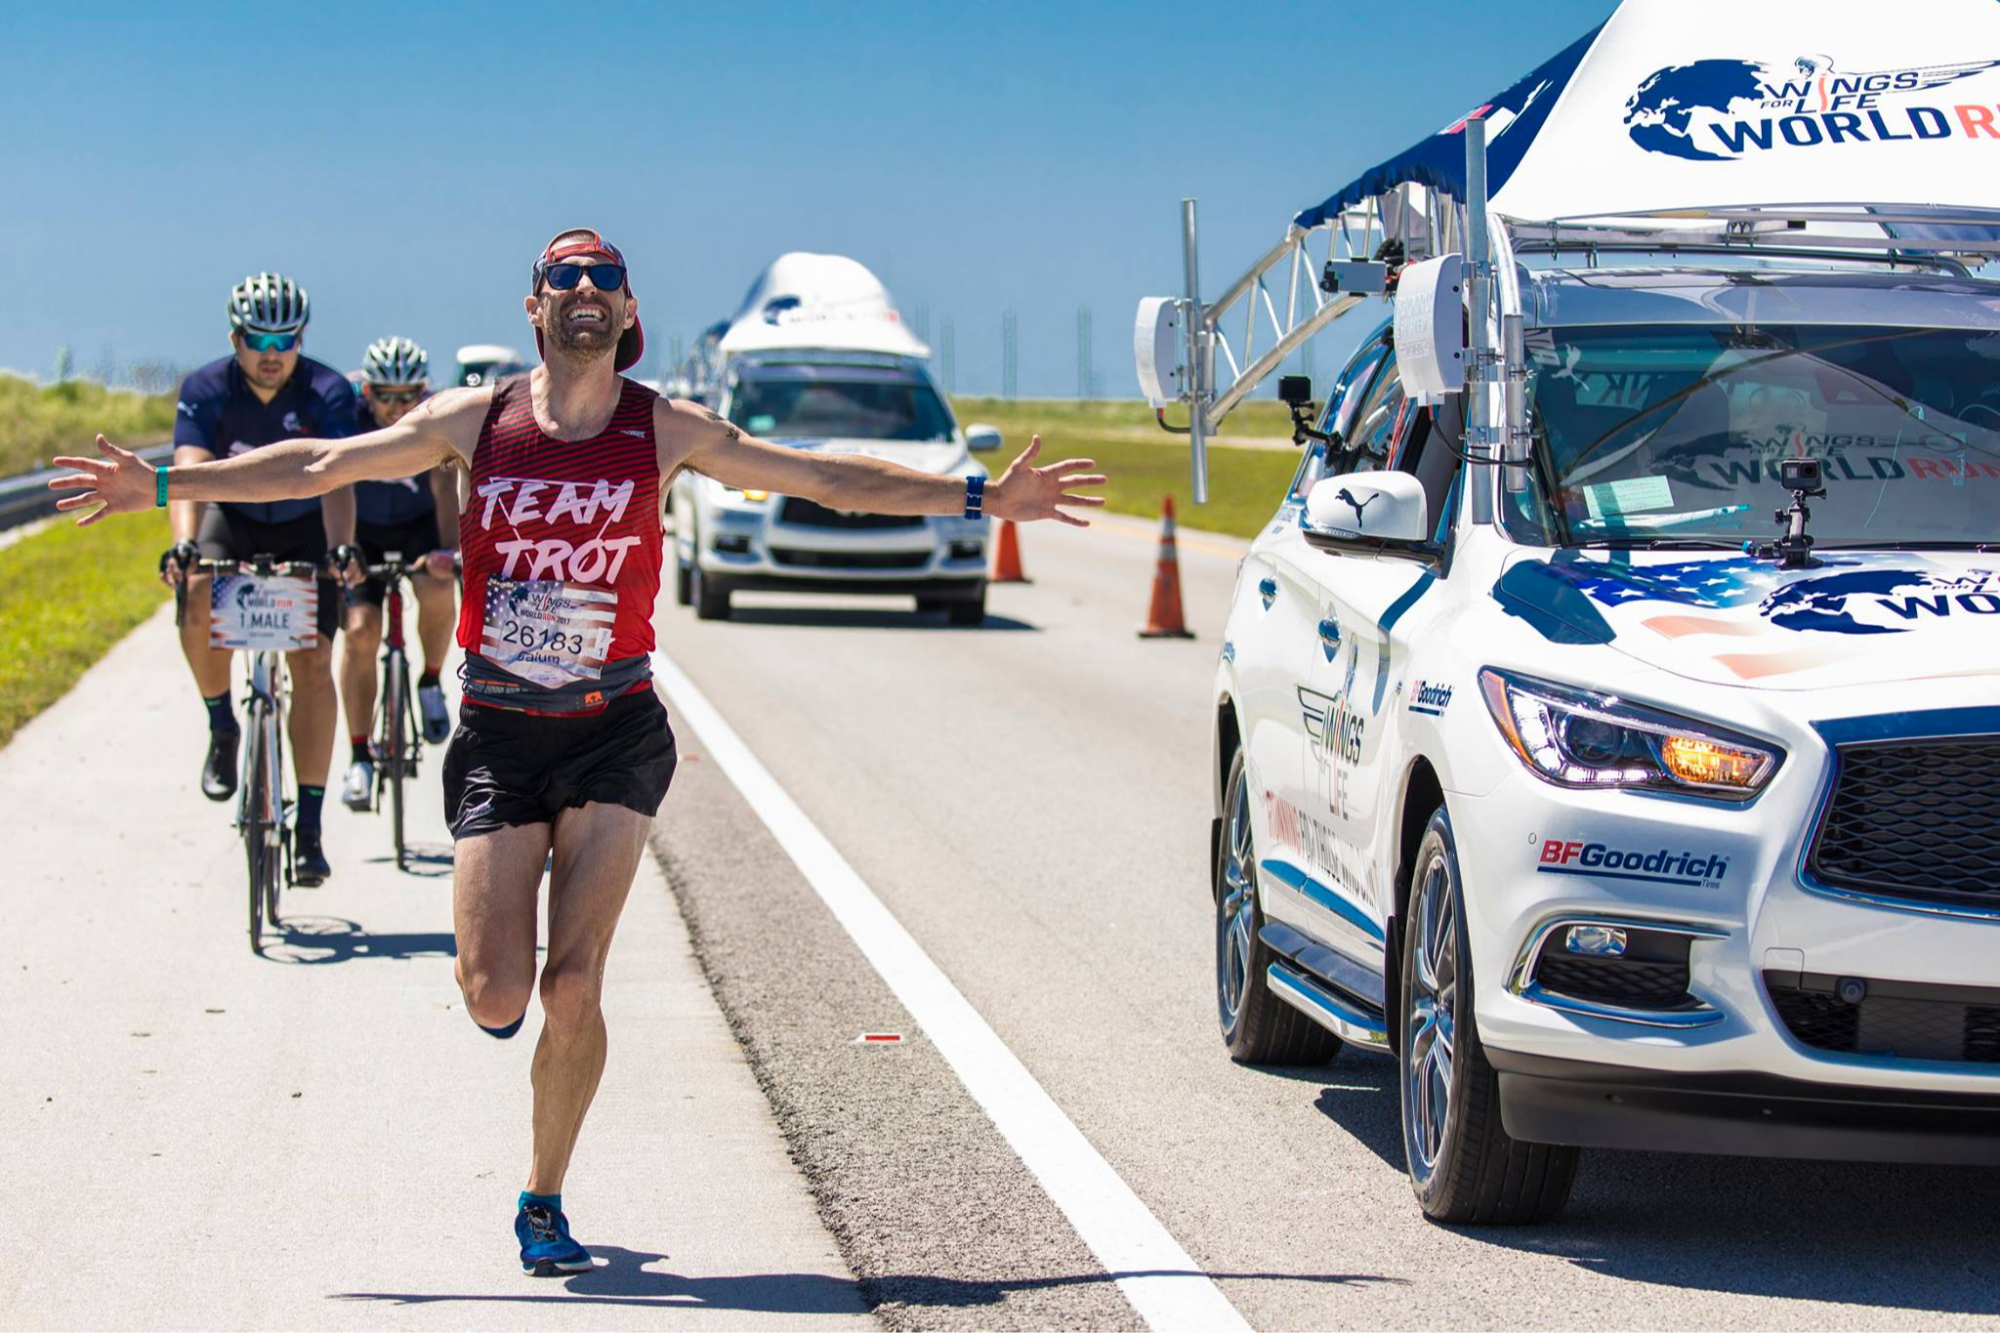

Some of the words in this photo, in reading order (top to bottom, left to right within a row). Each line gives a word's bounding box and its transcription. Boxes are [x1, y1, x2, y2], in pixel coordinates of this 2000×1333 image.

[1763, 71, 1919, 99] WINGS
[1760, 100, 1794, 109] FOR
[1794, 91, 1882, 114] LIFE
[1708, 107, 1952, 153] WORLD
[1953, 103, 2000, 139] R
[477, 478, 636, 531] TEAM
[495, 536, 642, 584] TROT
[531, 593, 571, 609] WINGS
[1874, 593, 2000, 620] WO
[251, 613, 290, 629] MALE
[520, 610, 542, 620] WORLD
[542, 611, 557, 622] RUN
[556, 615, 571, 625] 2017
[502, 620, 583, 655] 26183
[1539, 840, 1728, 880] BFGoodrich
[1701, 878, 1720, 889] Tires
